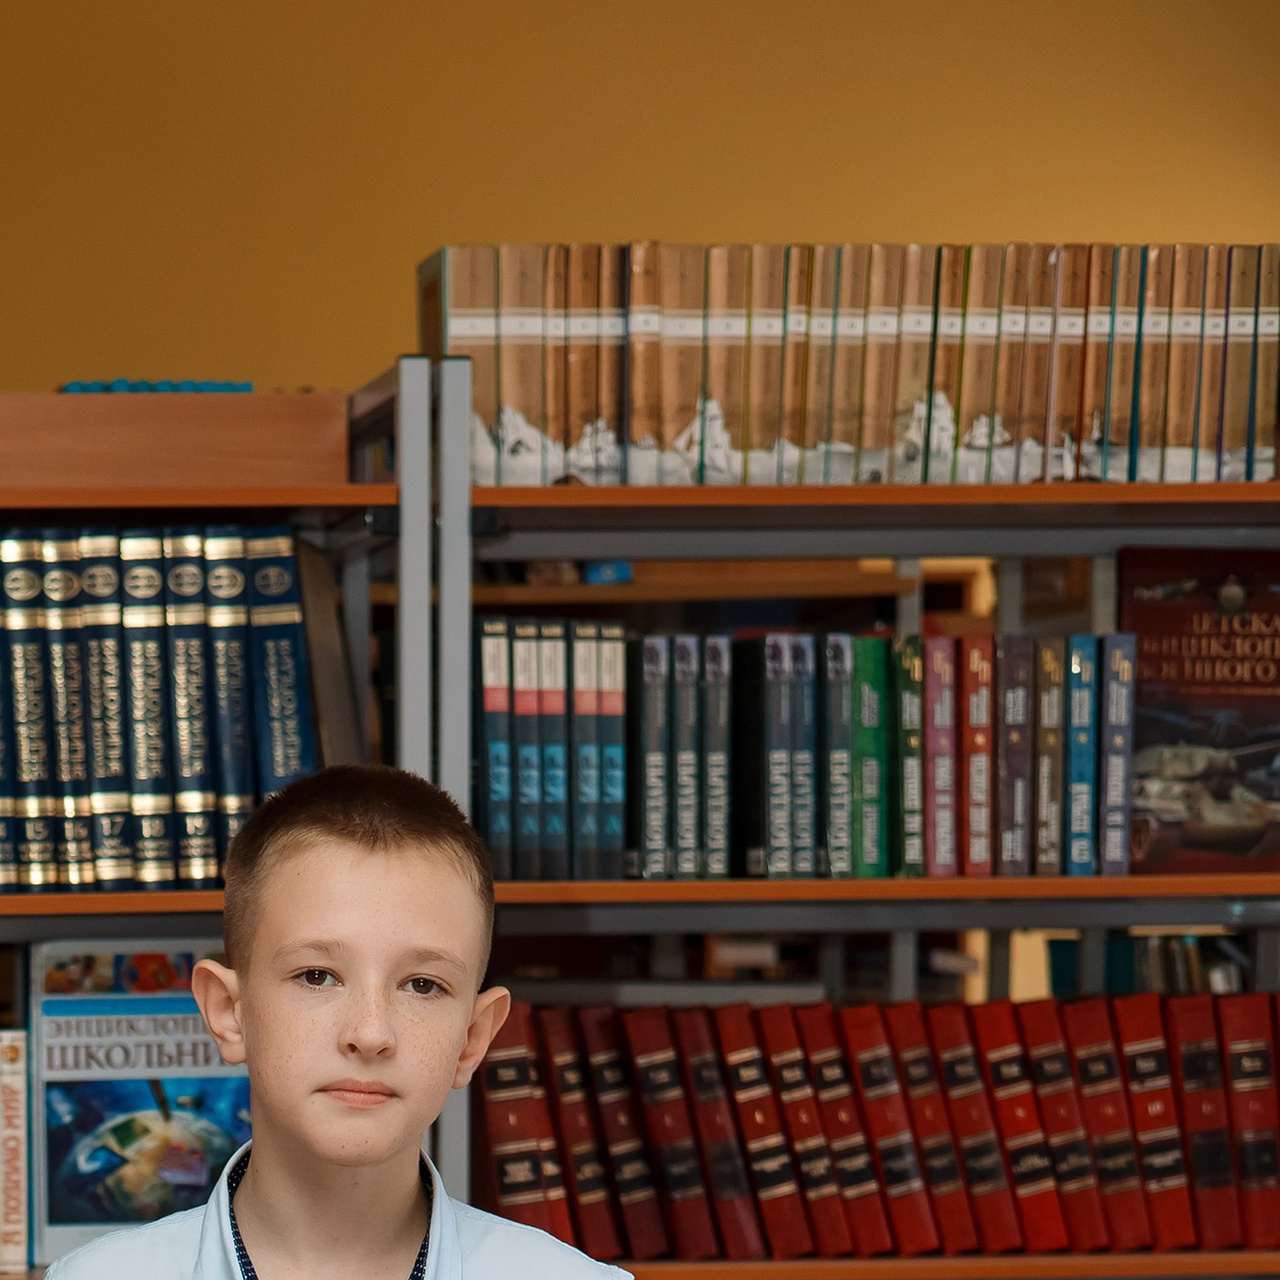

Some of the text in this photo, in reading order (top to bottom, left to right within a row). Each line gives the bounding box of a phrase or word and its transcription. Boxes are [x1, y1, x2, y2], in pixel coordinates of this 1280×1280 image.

[102, 638, 125, 777] ЭНЦИКЛОПЕДИЯ
[184, 640, 207, 776] ЭНЦИКЛОПЕДИЯ
[1, 1083, 22, 1247] Я ПОЗНАЮ МИР
